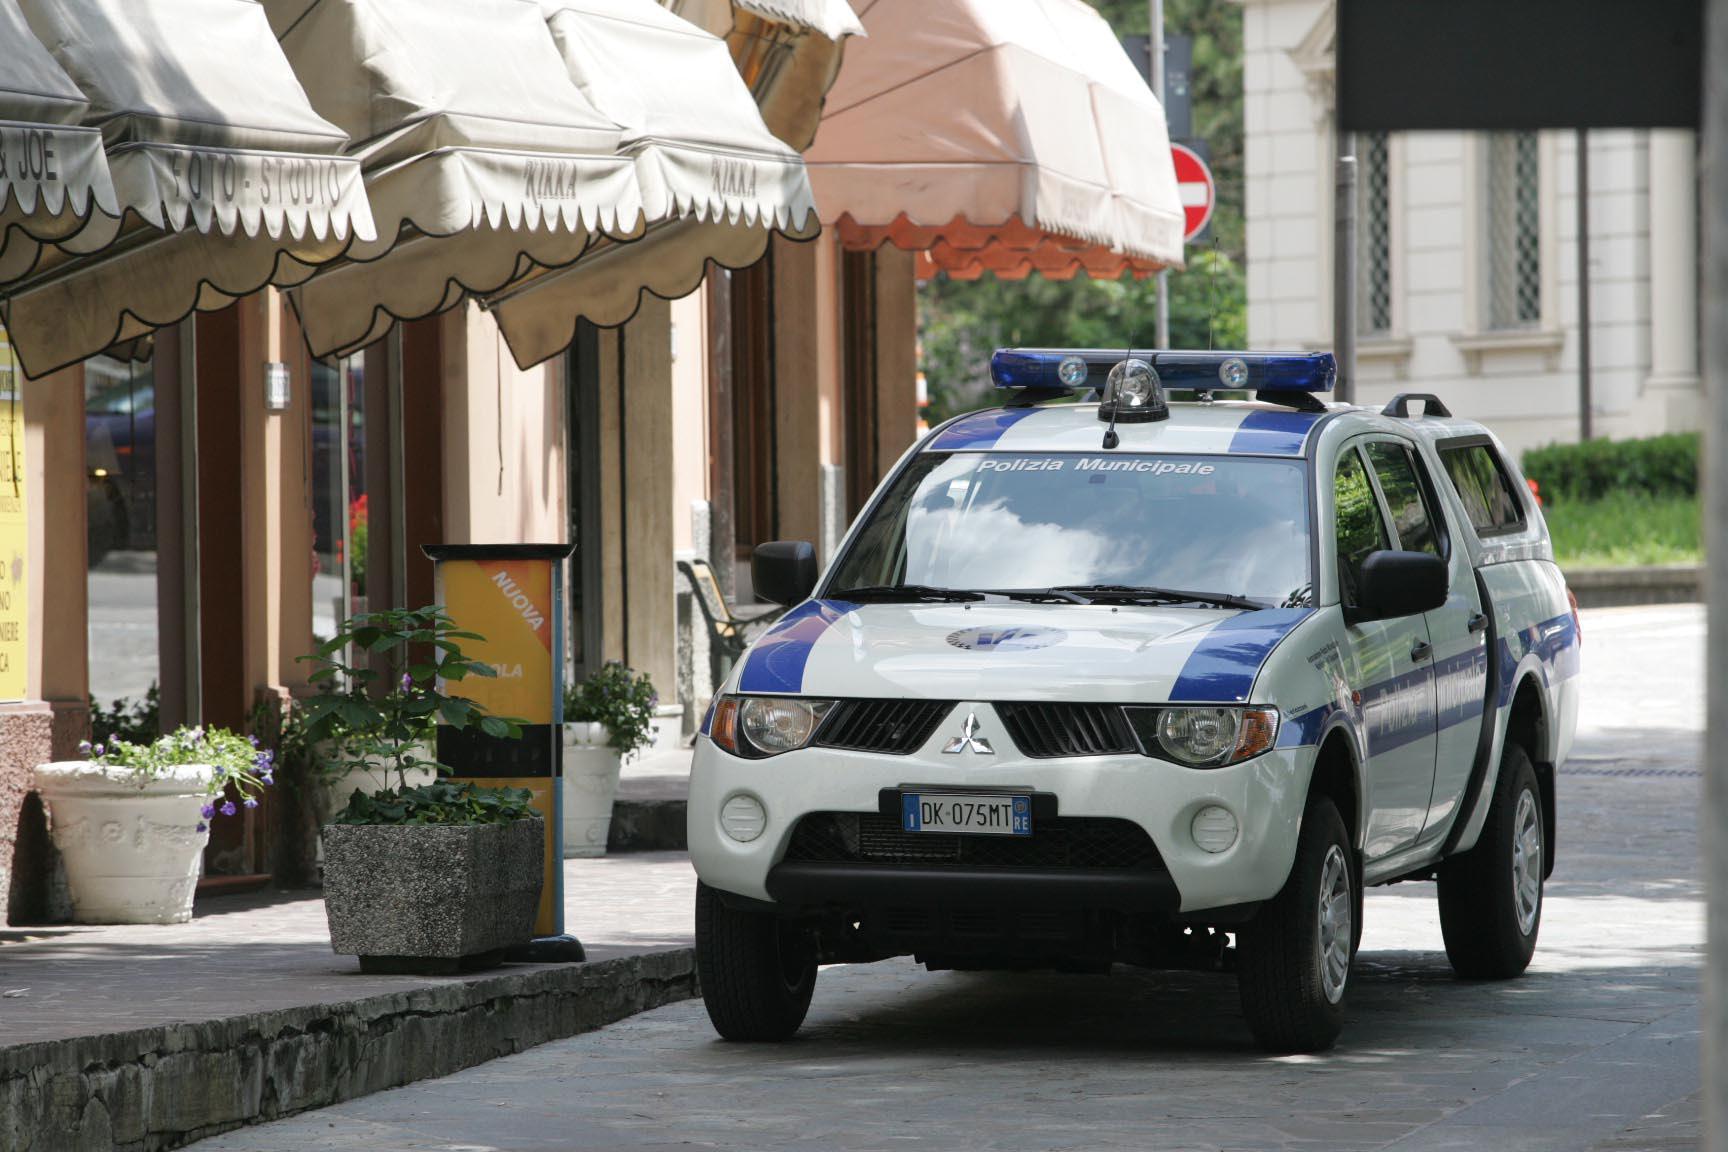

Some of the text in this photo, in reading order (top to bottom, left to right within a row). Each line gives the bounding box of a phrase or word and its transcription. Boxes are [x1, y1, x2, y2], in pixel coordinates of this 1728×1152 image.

[18, 129, 57, 181] JOE
[977, 458, 1216, 476] Polizia Municipale
[491, 571, 545, 631] NUOVA
[1014, 816, 1028, 830] RE
